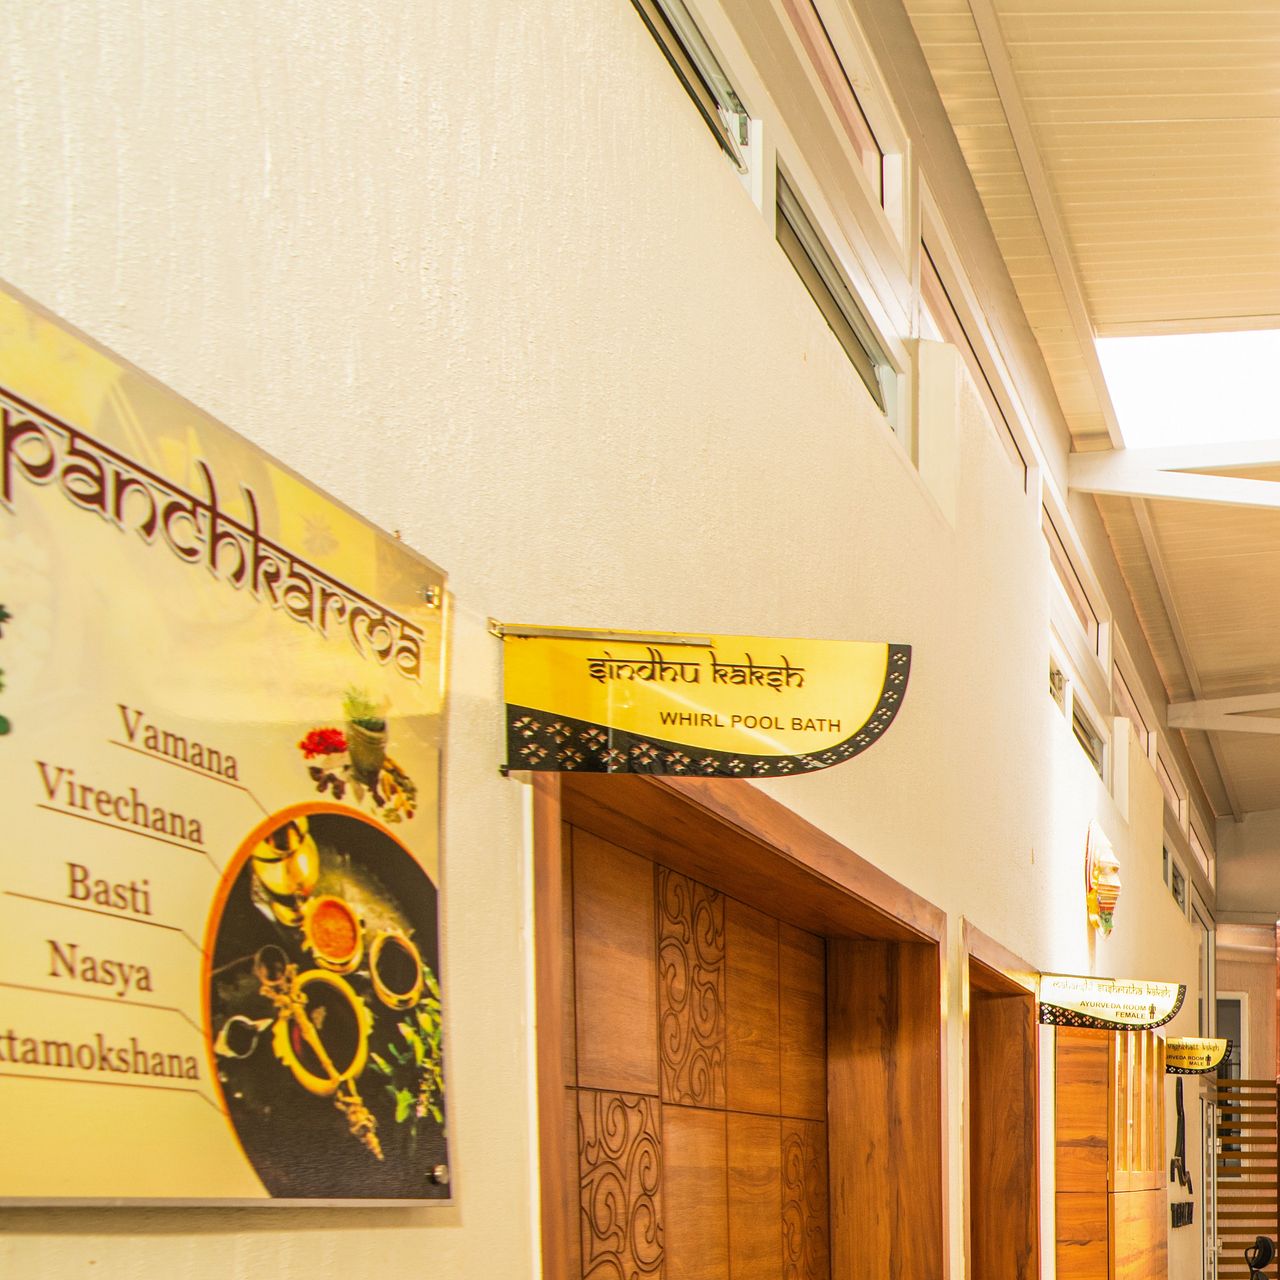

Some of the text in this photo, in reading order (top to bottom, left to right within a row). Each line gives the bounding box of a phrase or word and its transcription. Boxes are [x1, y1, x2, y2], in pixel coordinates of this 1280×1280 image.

[0, 387, 425, 680] panchkarma
[587, 647, 805, 690] sindhu kaksh
[117, 703, 239, 781] Vamana
[659, 711, 841, 733] WHIRL POOL BATH
[35, 760, 204, 844] Virechana
[66, 862, 153, 916] Basti
[46, 939, 153, 997] Nasya
[1080, 1000, 1147, 1011] AYURVEDA ROOM
[1115, 1011, 1145, 1019] FEMALE
